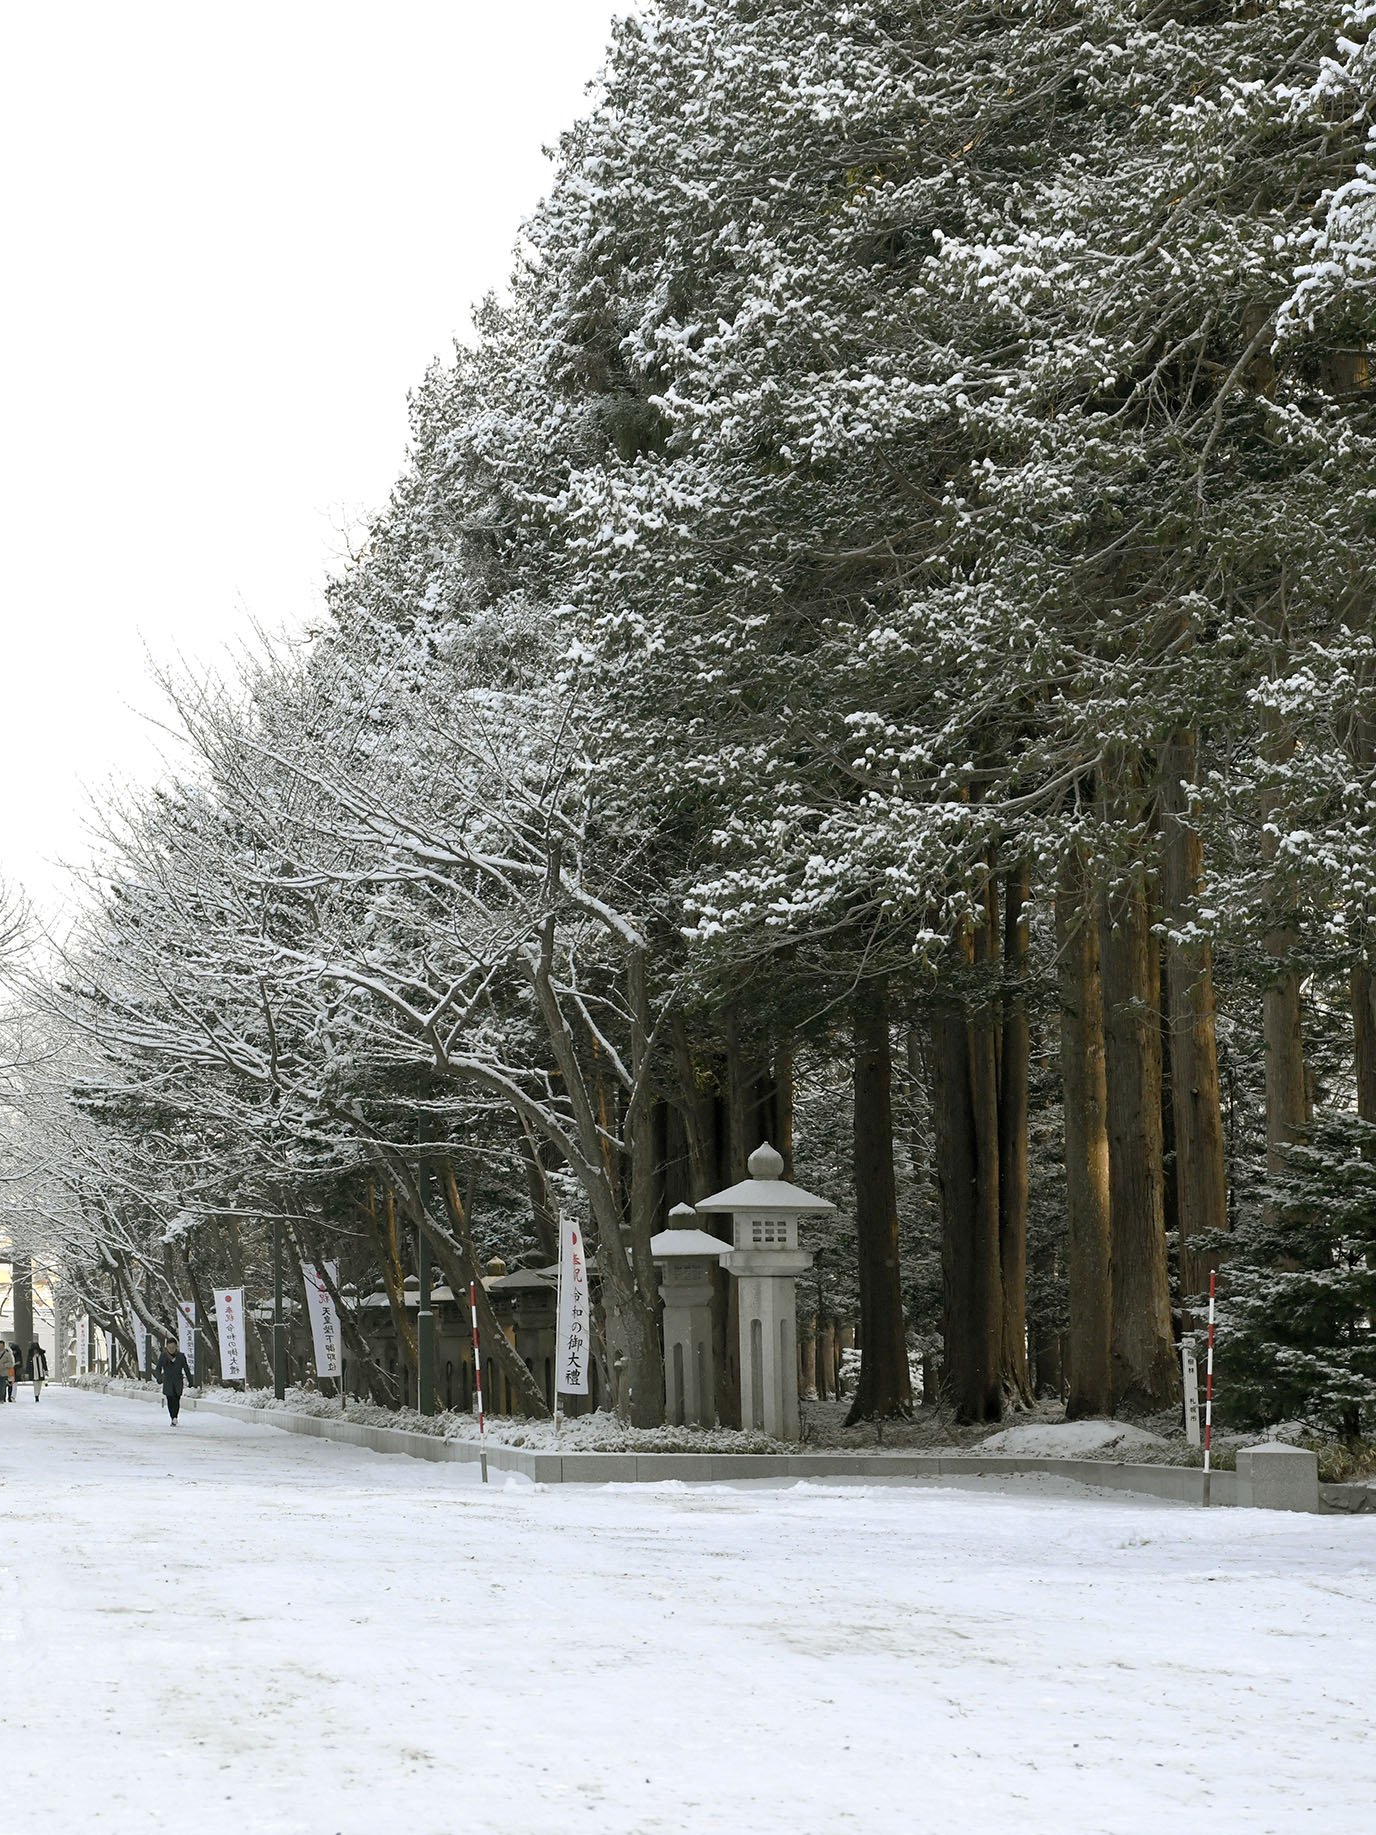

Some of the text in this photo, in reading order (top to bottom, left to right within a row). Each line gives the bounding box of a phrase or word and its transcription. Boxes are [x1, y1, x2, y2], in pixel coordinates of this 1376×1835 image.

[566, 1287, 583, 1386] 令和の御大禮
